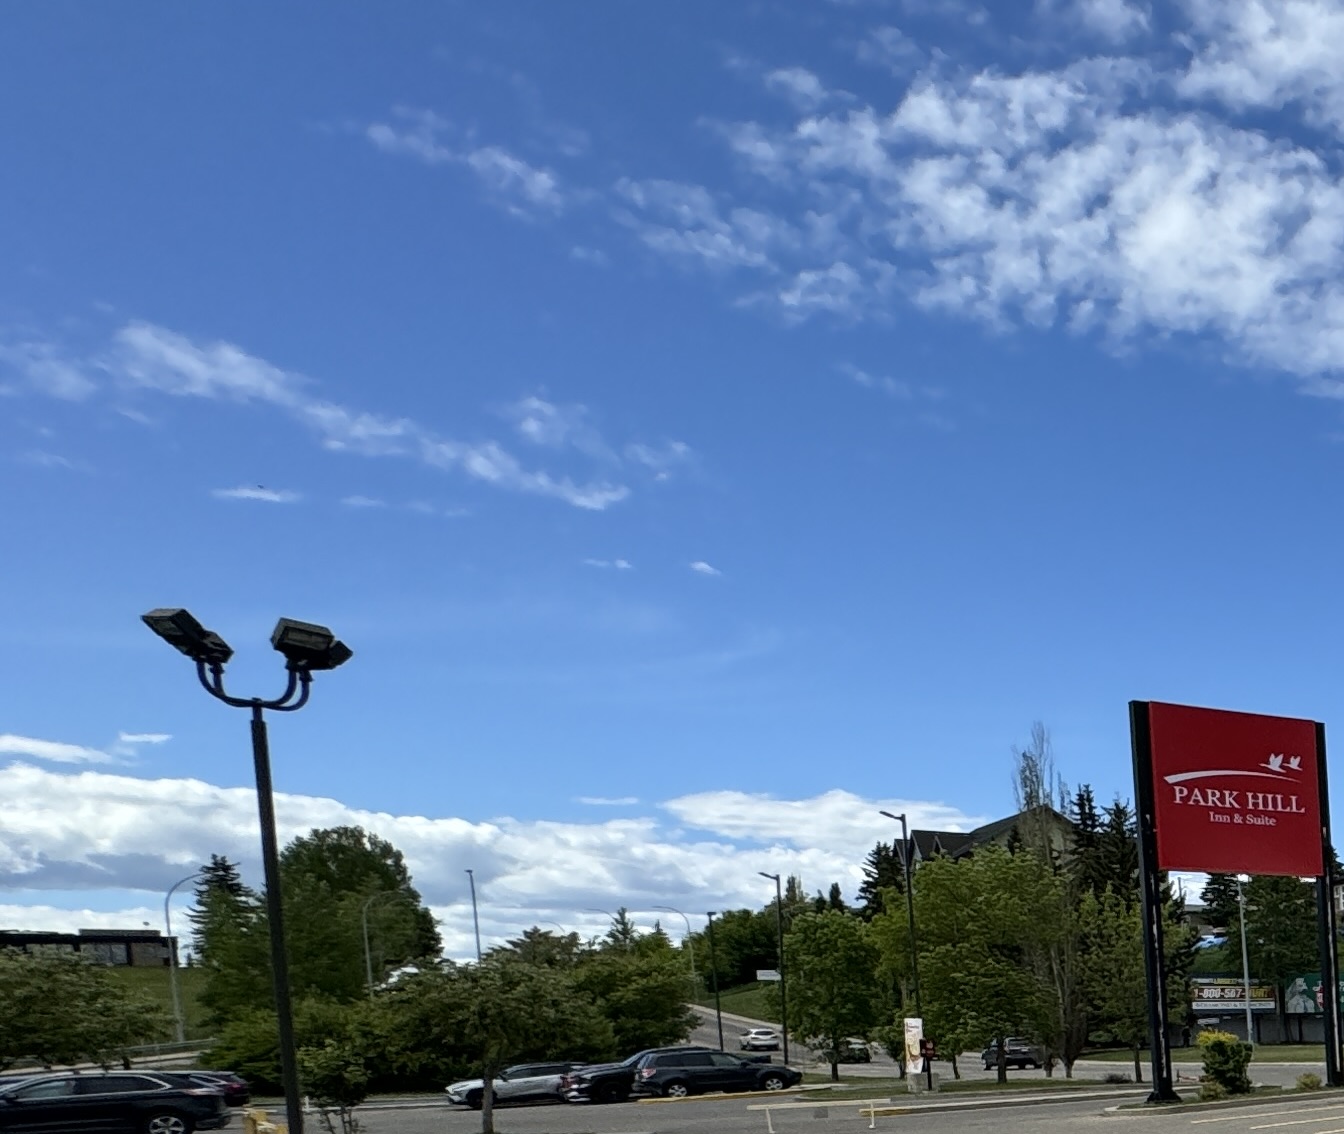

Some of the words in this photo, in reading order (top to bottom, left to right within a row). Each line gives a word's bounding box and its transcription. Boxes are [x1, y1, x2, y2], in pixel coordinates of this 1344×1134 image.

[1173, 786, 1241, 809] PARK
[1246, 792, 1306, 814] HILL
[1209, 811, 1231, 823] Inn
[1234, 813, 1243, 824] &
[1245, 814, 1277, 826] Suite
